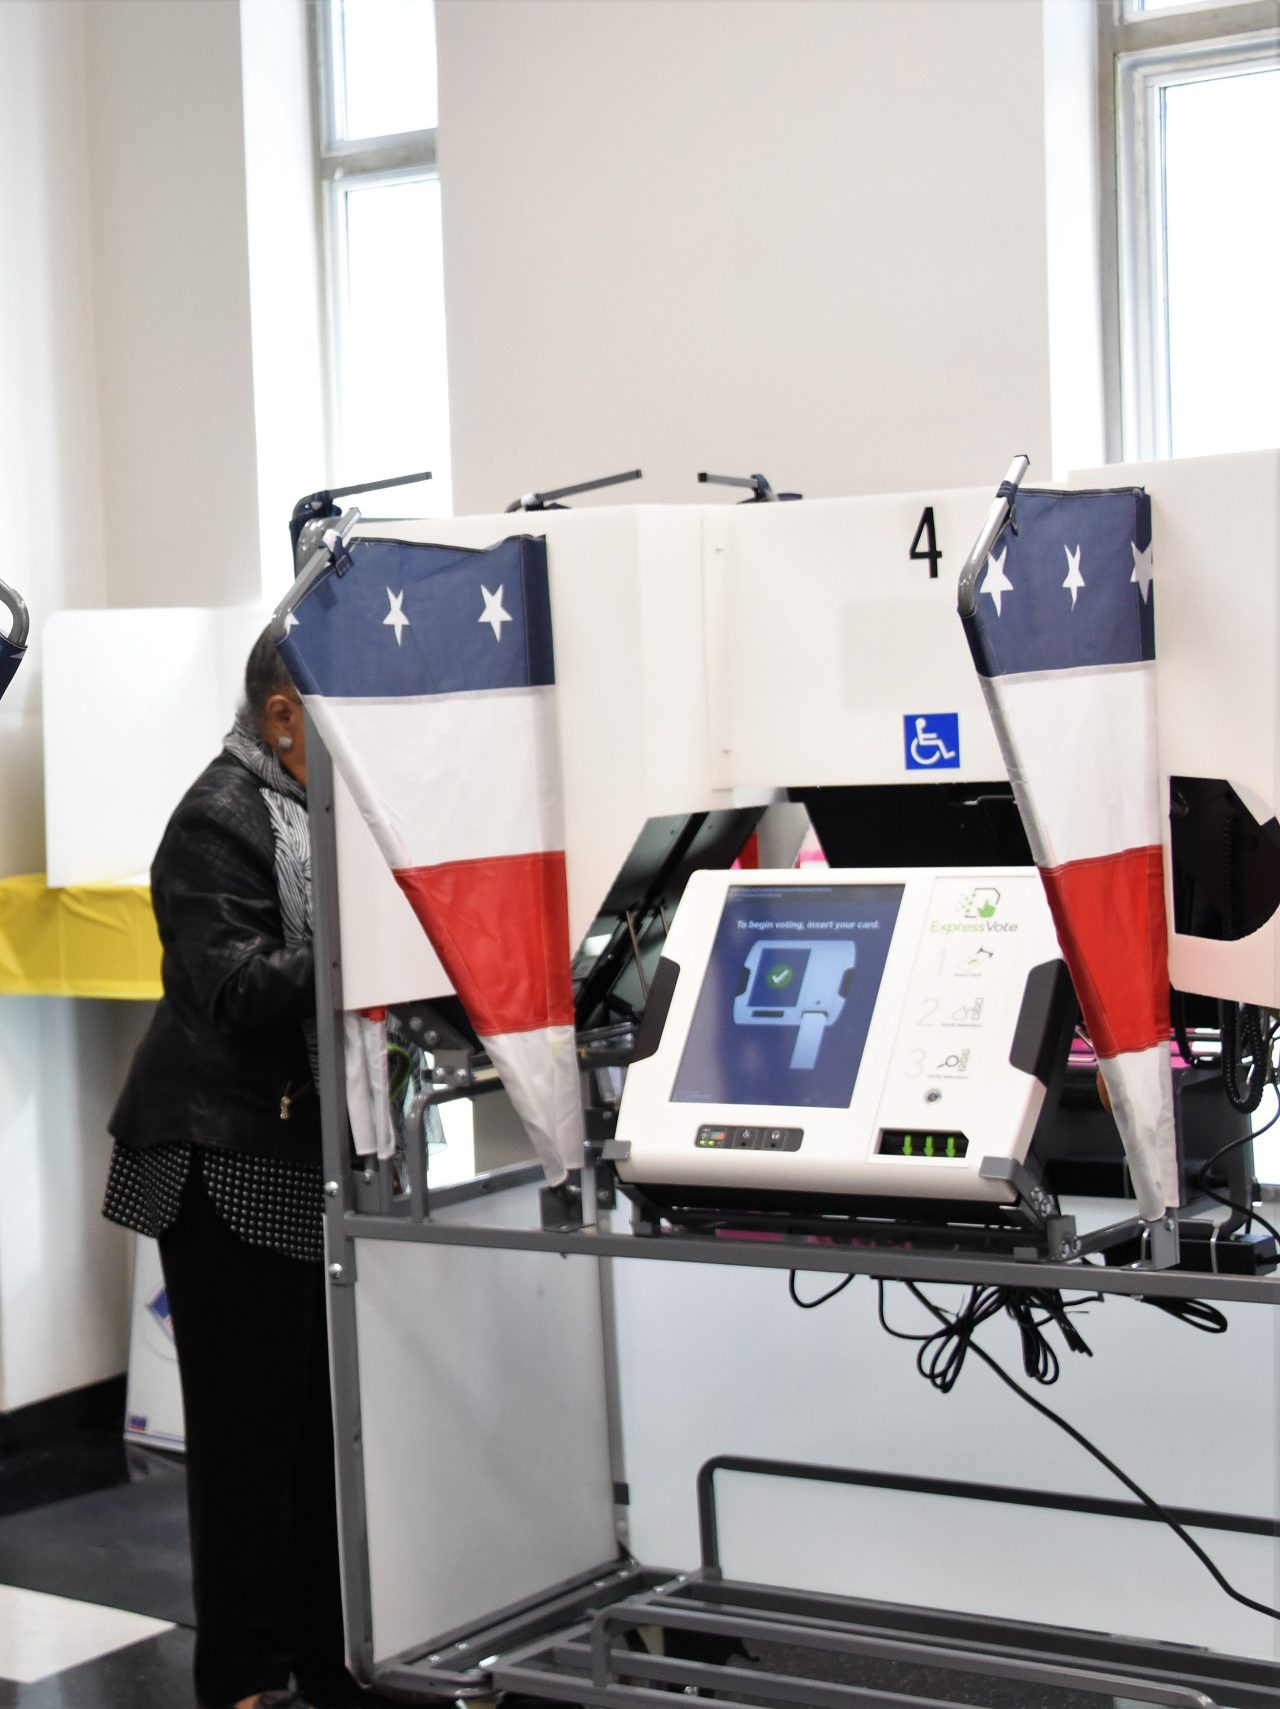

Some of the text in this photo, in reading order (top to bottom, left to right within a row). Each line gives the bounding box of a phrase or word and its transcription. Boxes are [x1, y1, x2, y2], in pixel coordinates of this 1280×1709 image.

[909, 506, 942, 578] 4
[737, 920, 747, 929] To
[748, 920, 773, 930] begin
[807, 920, 833, 929] insert
[835, 920, 855, 930] your
[930, 920, 1018, 934] ExpressVote
[915, 998, 940, 1026] 2
[904, 1047, 927, 1078] 3
